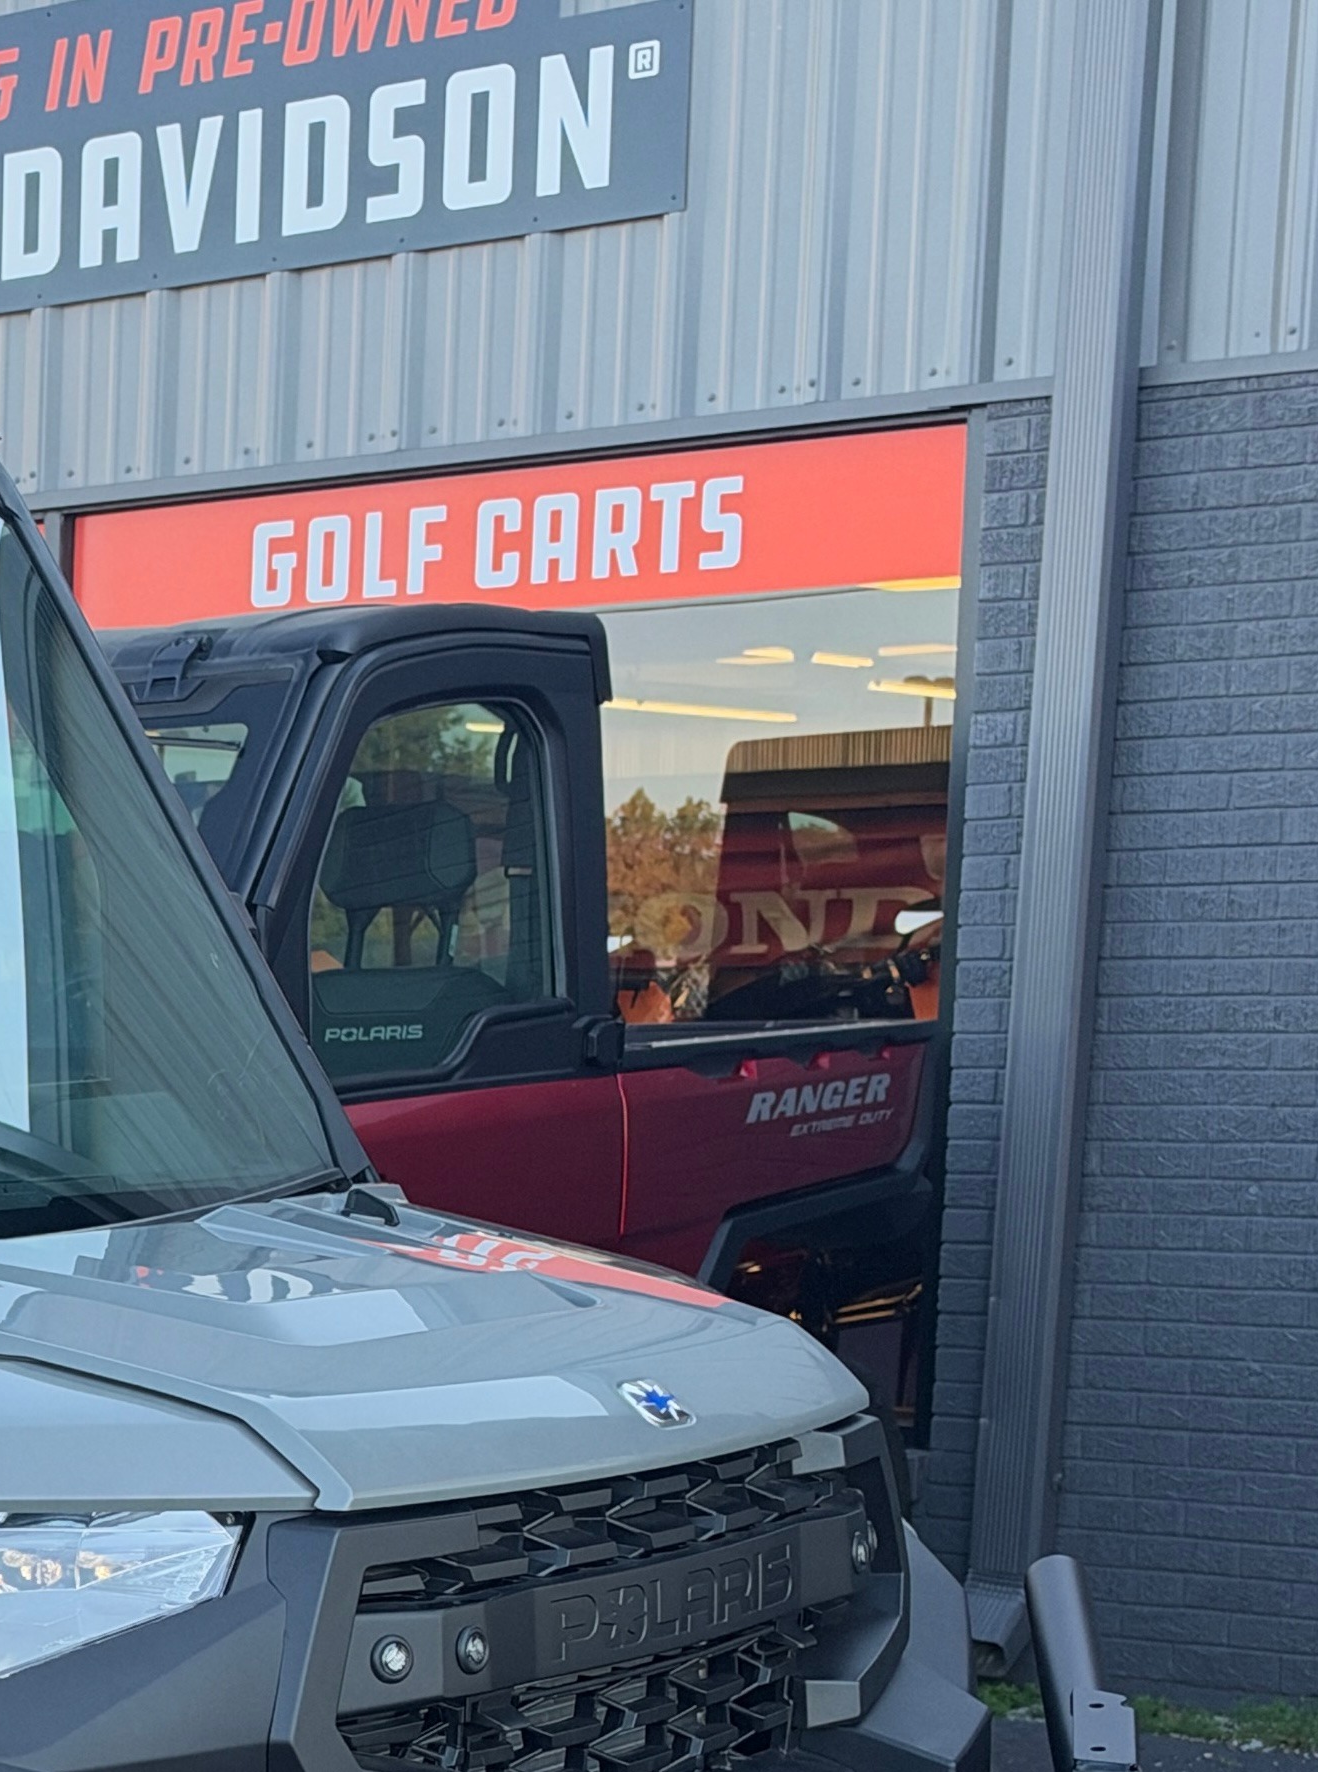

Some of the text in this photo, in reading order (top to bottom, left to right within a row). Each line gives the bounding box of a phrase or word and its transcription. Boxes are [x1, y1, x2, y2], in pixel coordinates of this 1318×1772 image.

[44, 29, 113, 112] IN
[250, 475, 744, 608] GOLF CARTS
[325, 1024, 423, 1042] POLARIS
[746, 1073, 891, 1124] RANGER
[550, 1544, 793, 1662] POLARIS
